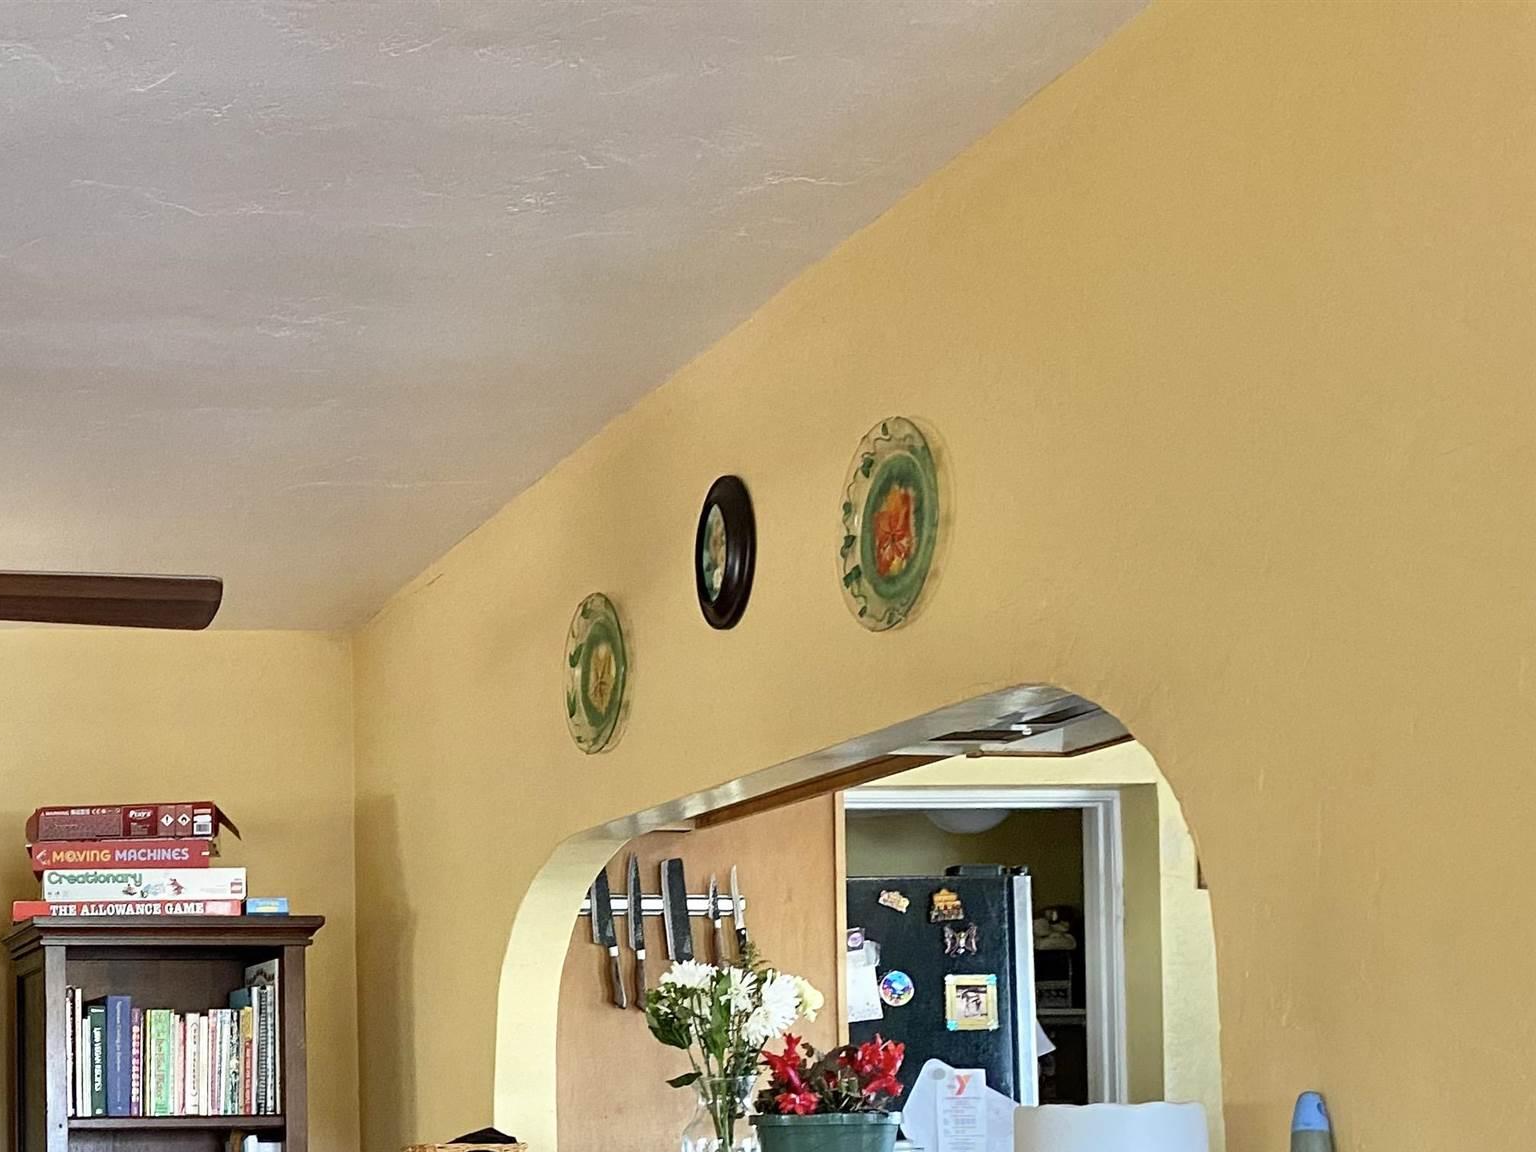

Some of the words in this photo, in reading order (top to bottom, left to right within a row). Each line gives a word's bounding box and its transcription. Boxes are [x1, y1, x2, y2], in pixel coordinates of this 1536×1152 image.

[52, 849, 111, 862] MOVING
[115, 848, 189, 861] MACHINES
[47, 871, 143, 888] Creationary
[50, 904, 77, 916] THE
[80, 903, 161, 916] ALLOWANCE
[165, 902, 204, 914] GAME
